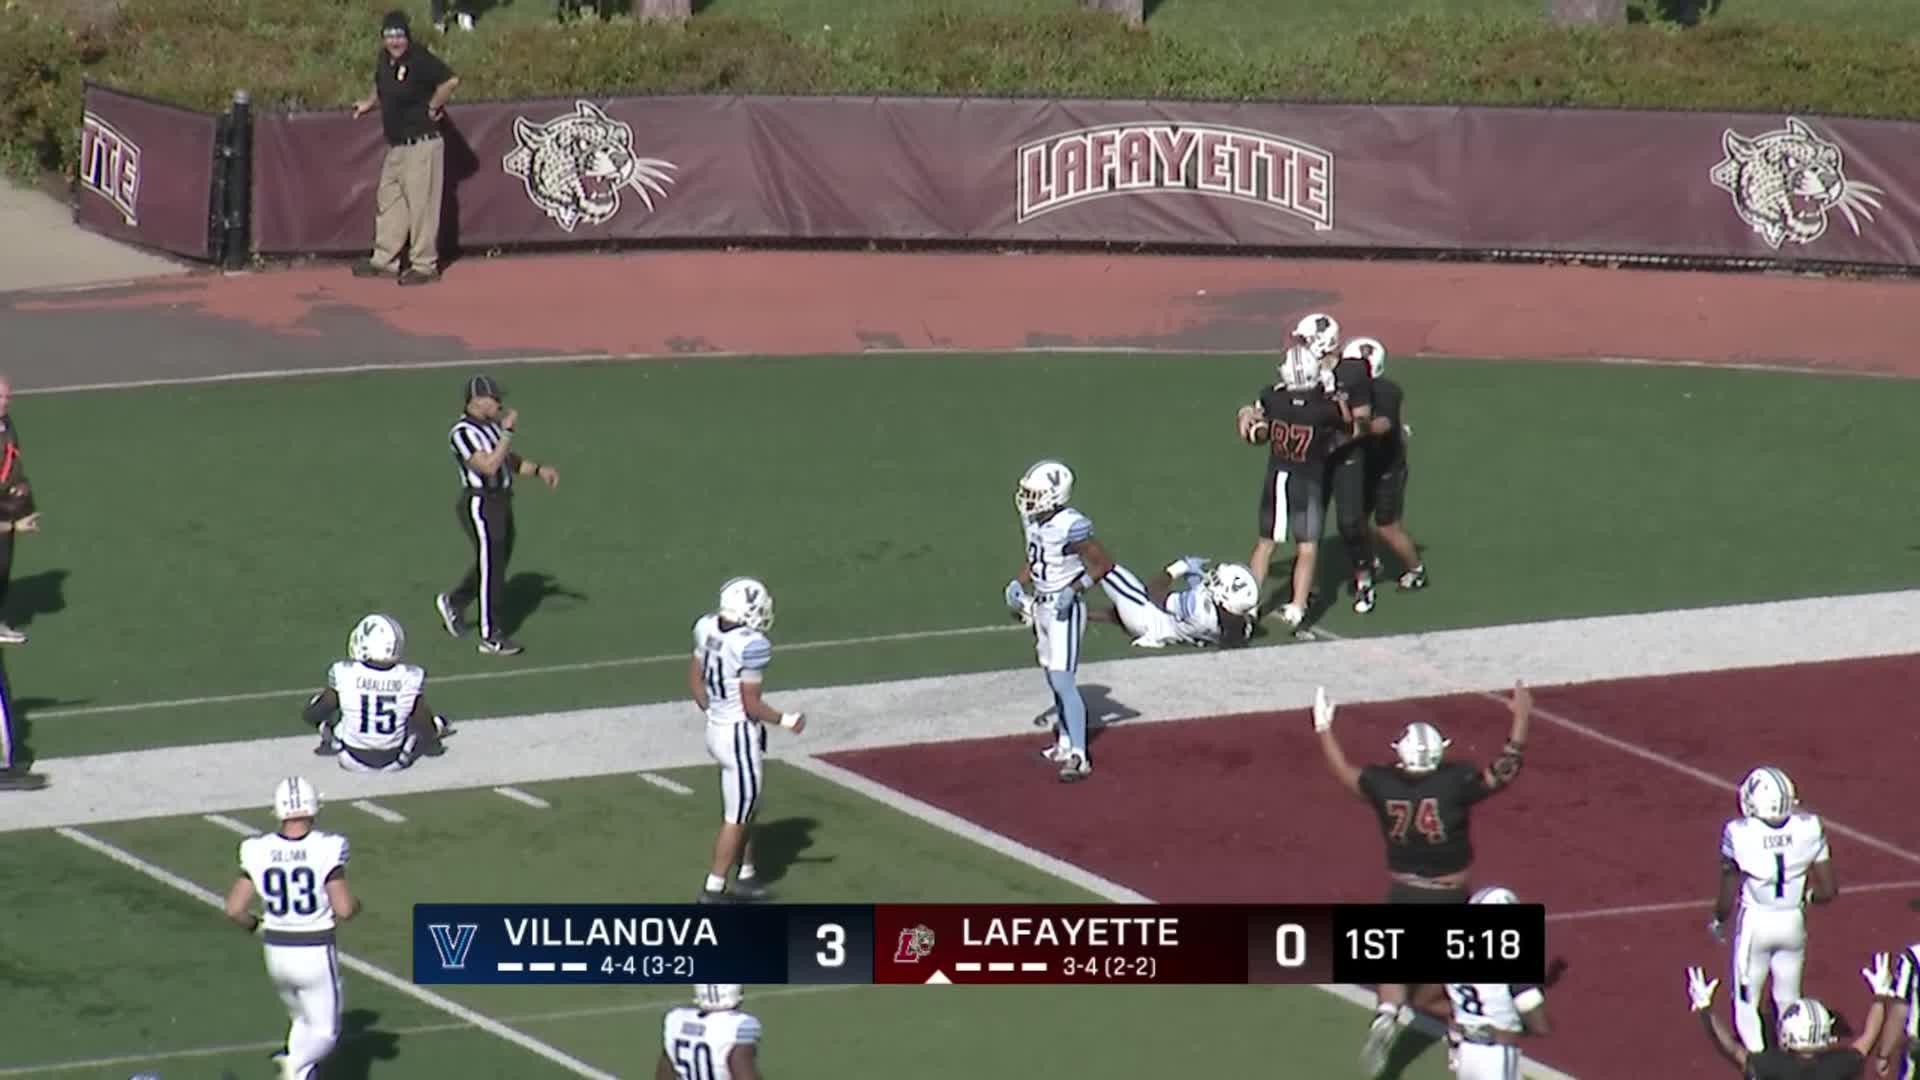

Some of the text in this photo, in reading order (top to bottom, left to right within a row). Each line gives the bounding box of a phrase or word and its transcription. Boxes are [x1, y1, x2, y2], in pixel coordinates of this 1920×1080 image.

[81, 111, 140, 225] TTE
[1018, 122, 1333, 230] LAFAYETTE
[1270, 420, 1314, 462] 87
[1048, 471, 1060, 486] V
[1029, 541, 1047, 581] 21
[745, 587, 759, 603] V
[363, 622, 376, 636] V
[702, 650, 727, 699] 41
[360, 694, 397, 734] 15
[1387, 798, 1447, 844] 74
[263, 866, 317, 916] 93
[1775, 853, 1785, 898] 1
[674, 1039, 715, 1080] 50
